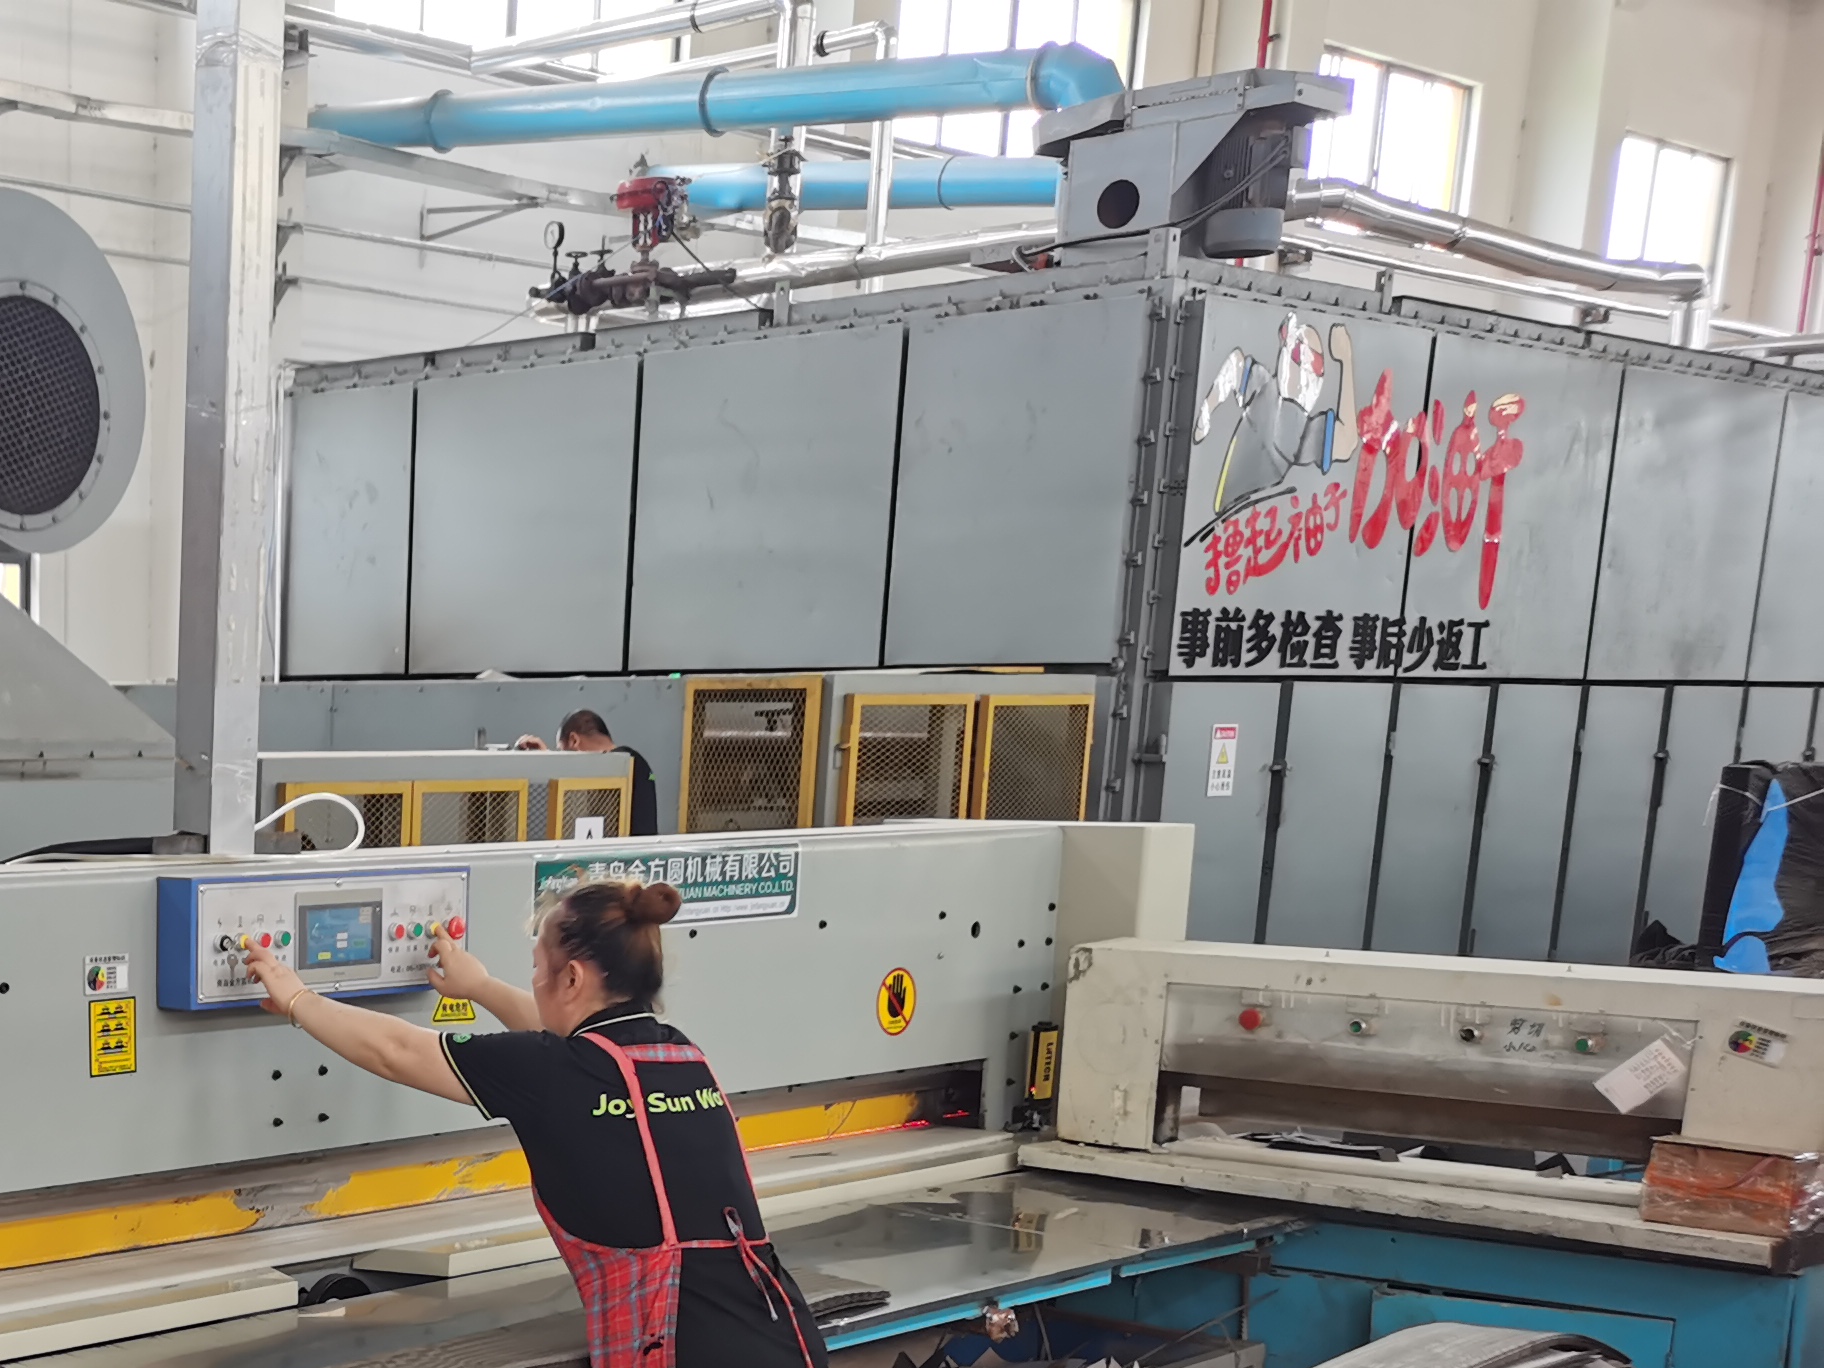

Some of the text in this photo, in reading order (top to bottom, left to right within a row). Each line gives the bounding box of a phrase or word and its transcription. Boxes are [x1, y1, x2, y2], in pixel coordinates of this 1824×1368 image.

[1176, 607, 1491, 673] 事前多检查 事后少返工
[703, 881, 758, 899] MACHINERY
[647, 1092, 696, 1113] Sun
